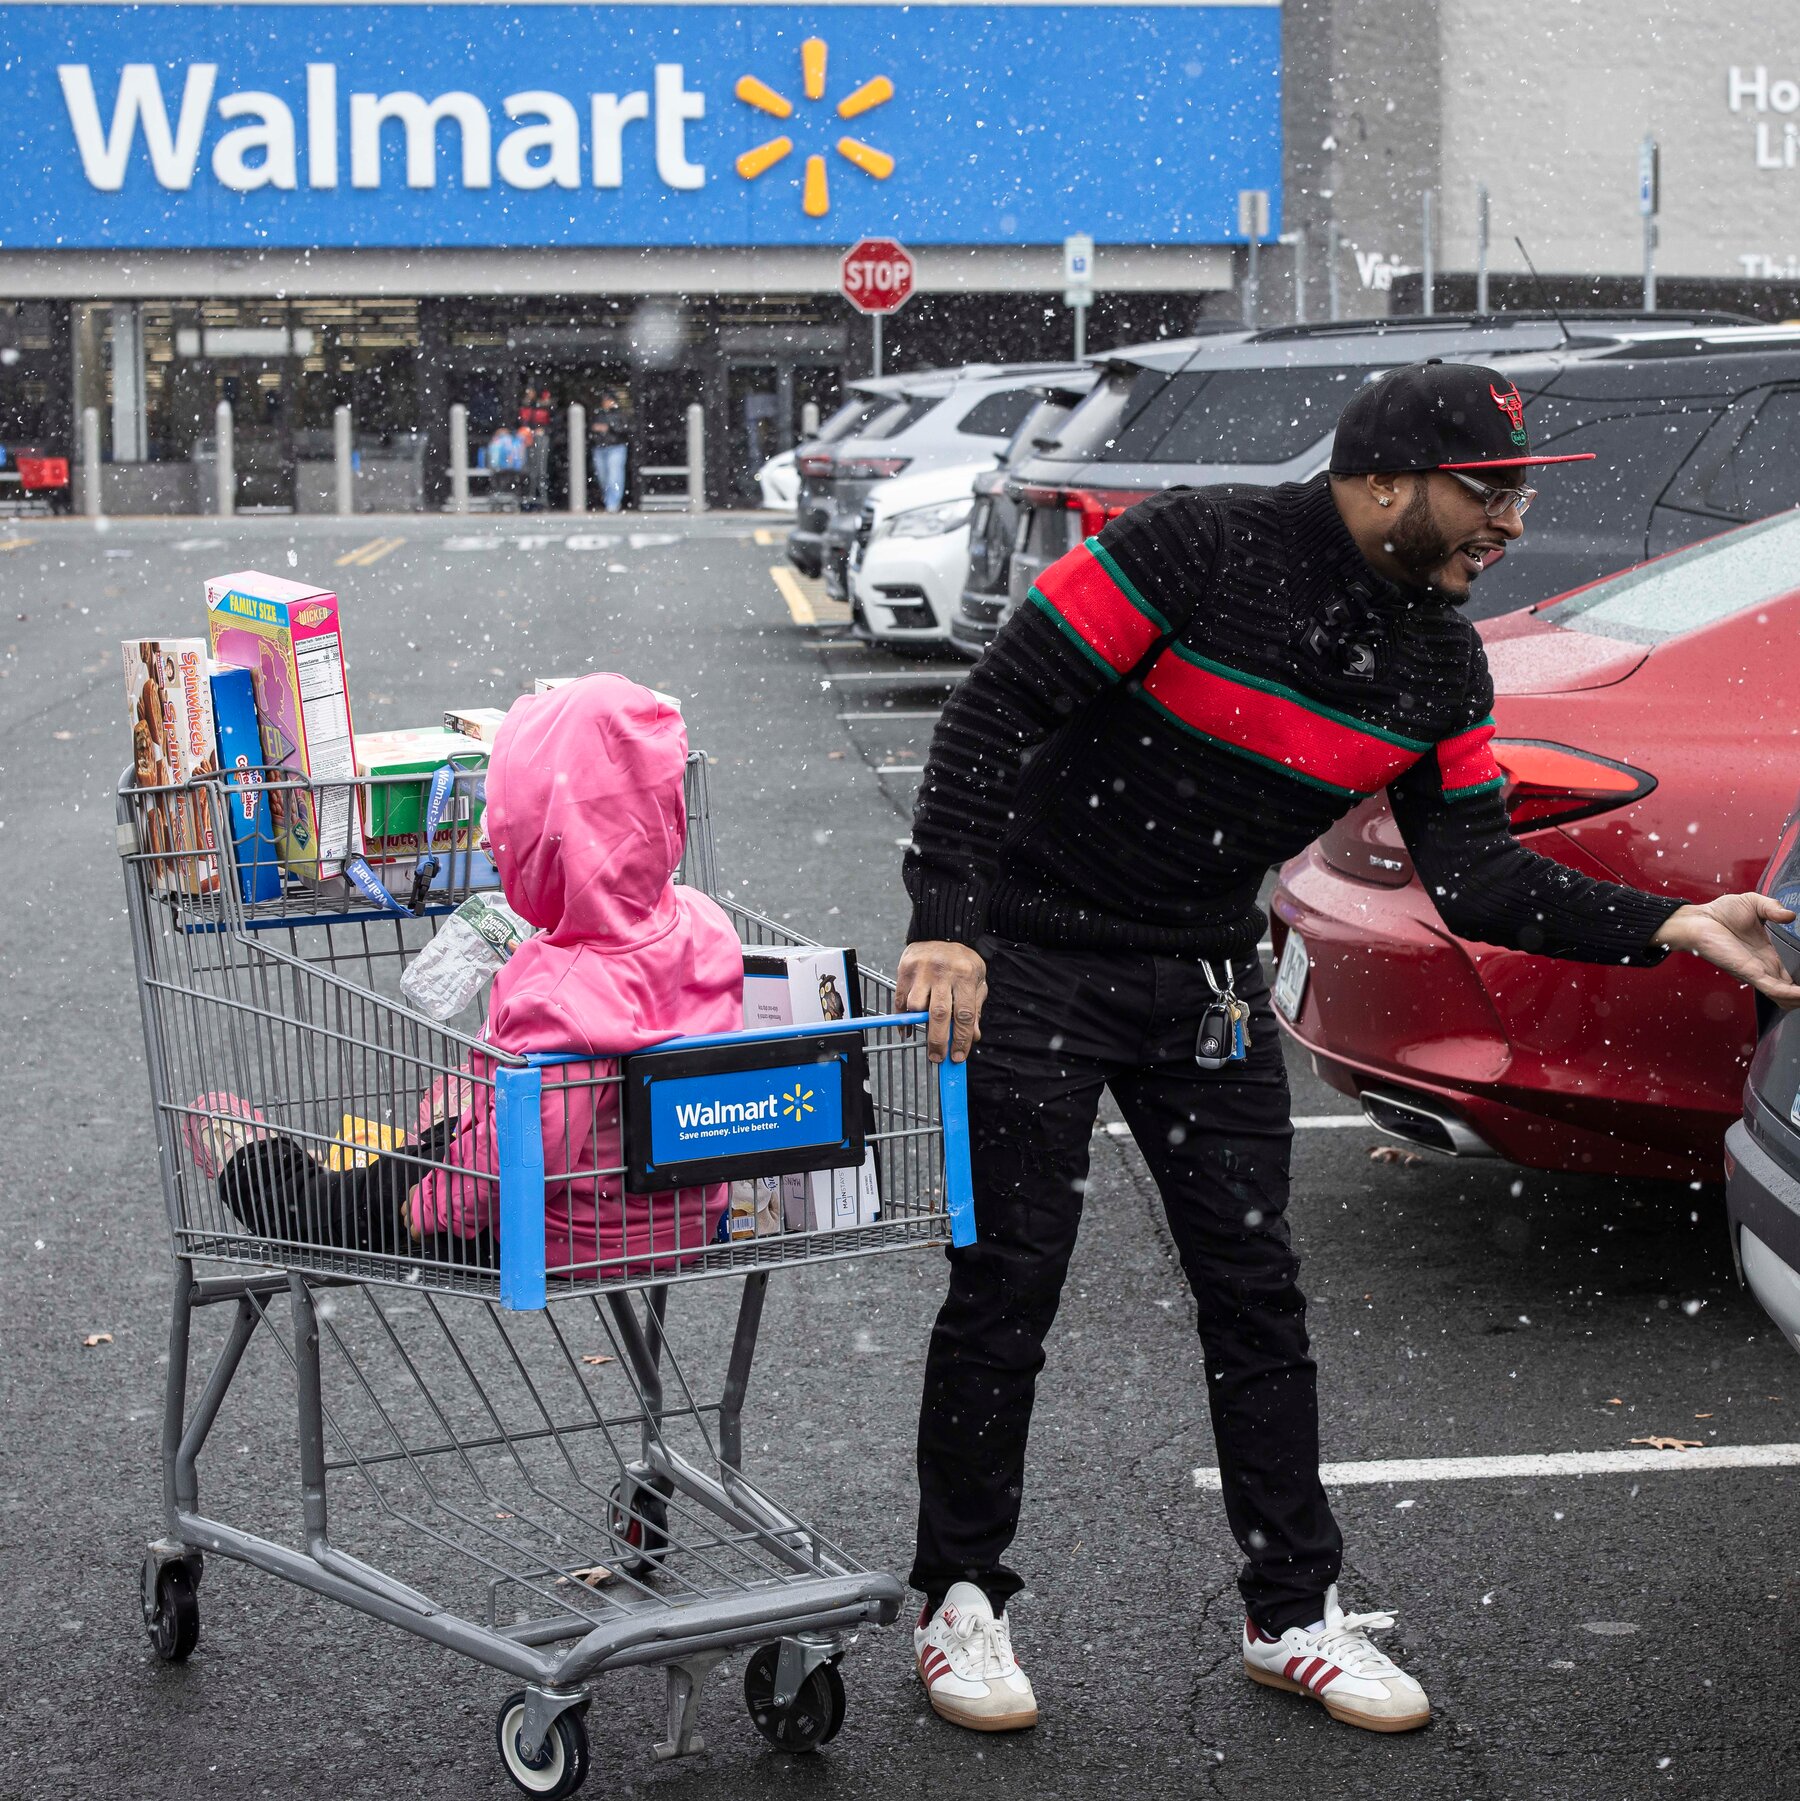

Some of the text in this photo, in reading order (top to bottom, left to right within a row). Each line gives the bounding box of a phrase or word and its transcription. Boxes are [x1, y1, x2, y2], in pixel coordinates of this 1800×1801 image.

[57, 63, 705, 191] Walmart
[1756, 122, 1800, 168] Li
[845, 260, 911, 289] STOP
[229, 593, 277, 620] FAMILY SIZE
[298, 606, 328, 626] WICKED
[181, 652, 203, 756] Spinwheels
[431, 770, 450, 815] Walmart
[479, 917, 507, 944] Spring
[485, 911, 512, 937] Poland
[676, 1095, 777, 1128] Walmart
[679, 1122, 780, 1140] Save money. Live better.
[840, 1170, 848, 1209] MAINSTAYS
